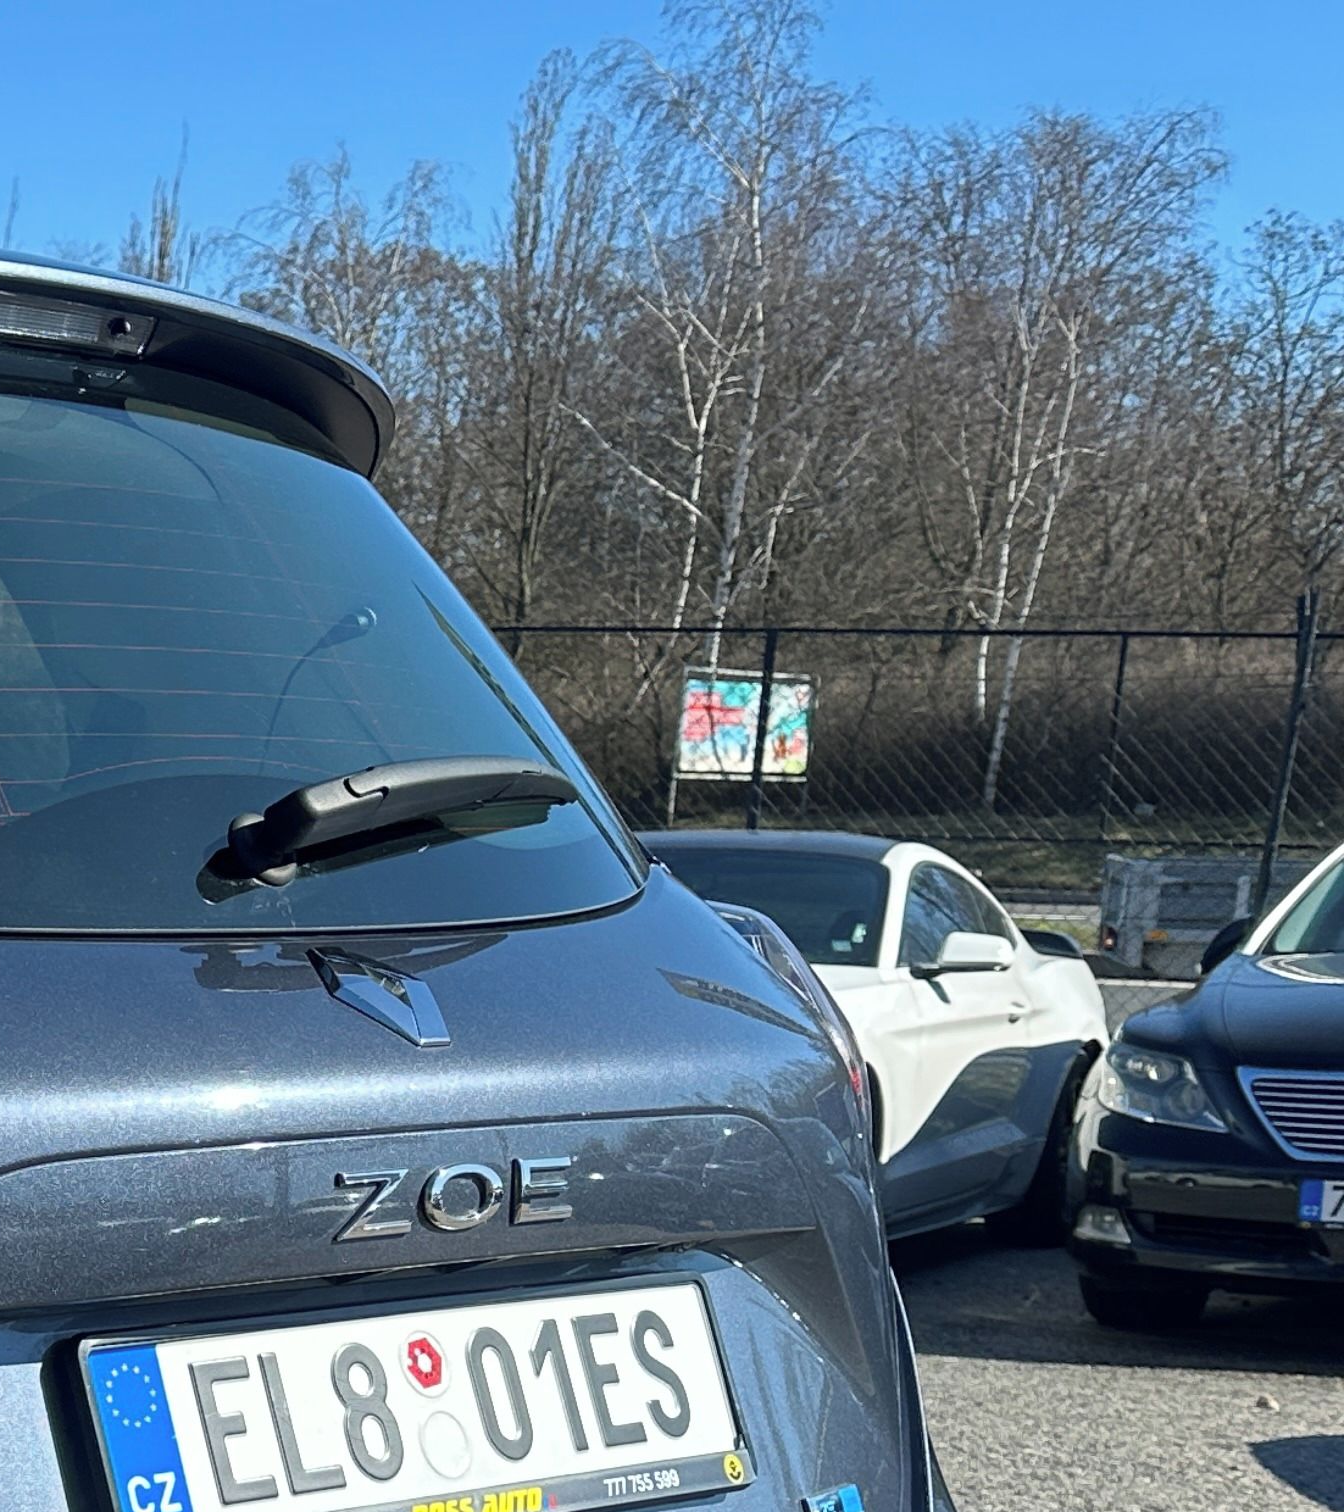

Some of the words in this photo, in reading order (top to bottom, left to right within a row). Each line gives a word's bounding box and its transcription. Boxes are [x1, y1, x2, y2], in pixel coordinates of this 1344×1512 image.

[332, 1156, 573, 1243] ZOE
[188, 1342, 404, 1505] EL8
[465, 1310, 691, 1460] 01ES
